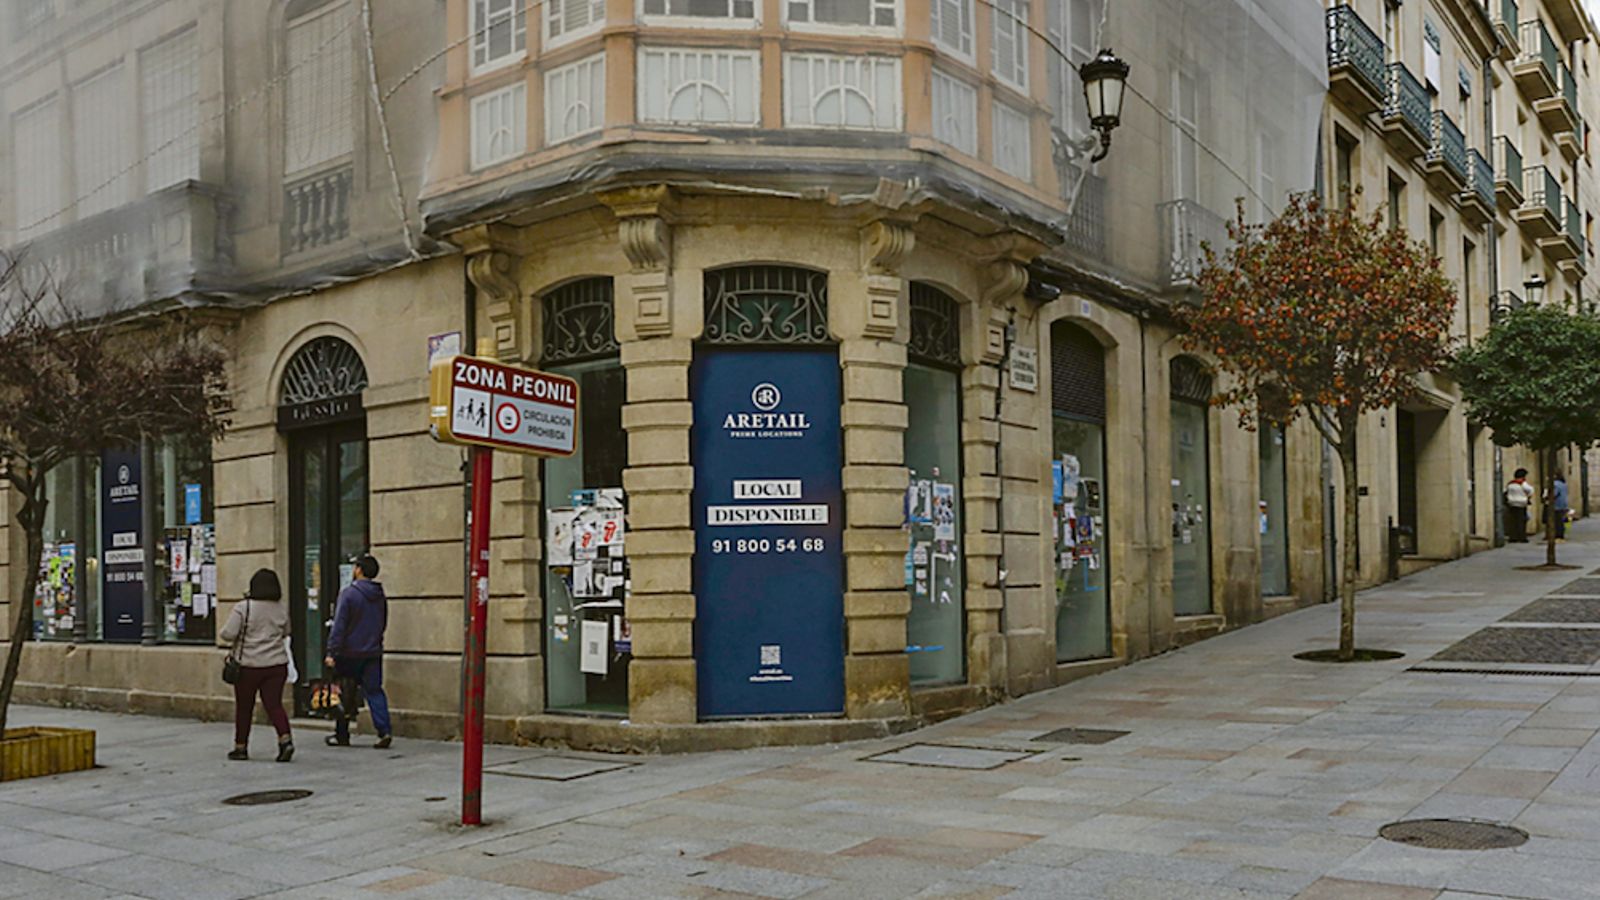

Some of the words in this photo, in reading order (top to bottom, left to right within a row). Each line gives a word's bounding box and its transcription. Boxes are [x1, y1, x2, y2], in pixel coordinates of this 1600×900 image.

[455, 362, 506, 390] ZONA
[511, 374, 575, 404] PEONIL
[723, 413, 810, 428] ARETAIL
[741, 483, 797, 496] LOCAL
[715, 508, 823, 522] DISPONIBLE
[712, 540, 730, 553] 91
[737, 539, 770, 552] 800
[776, 539, 797, 552] 54
[802, 538, 824, 552] 68
